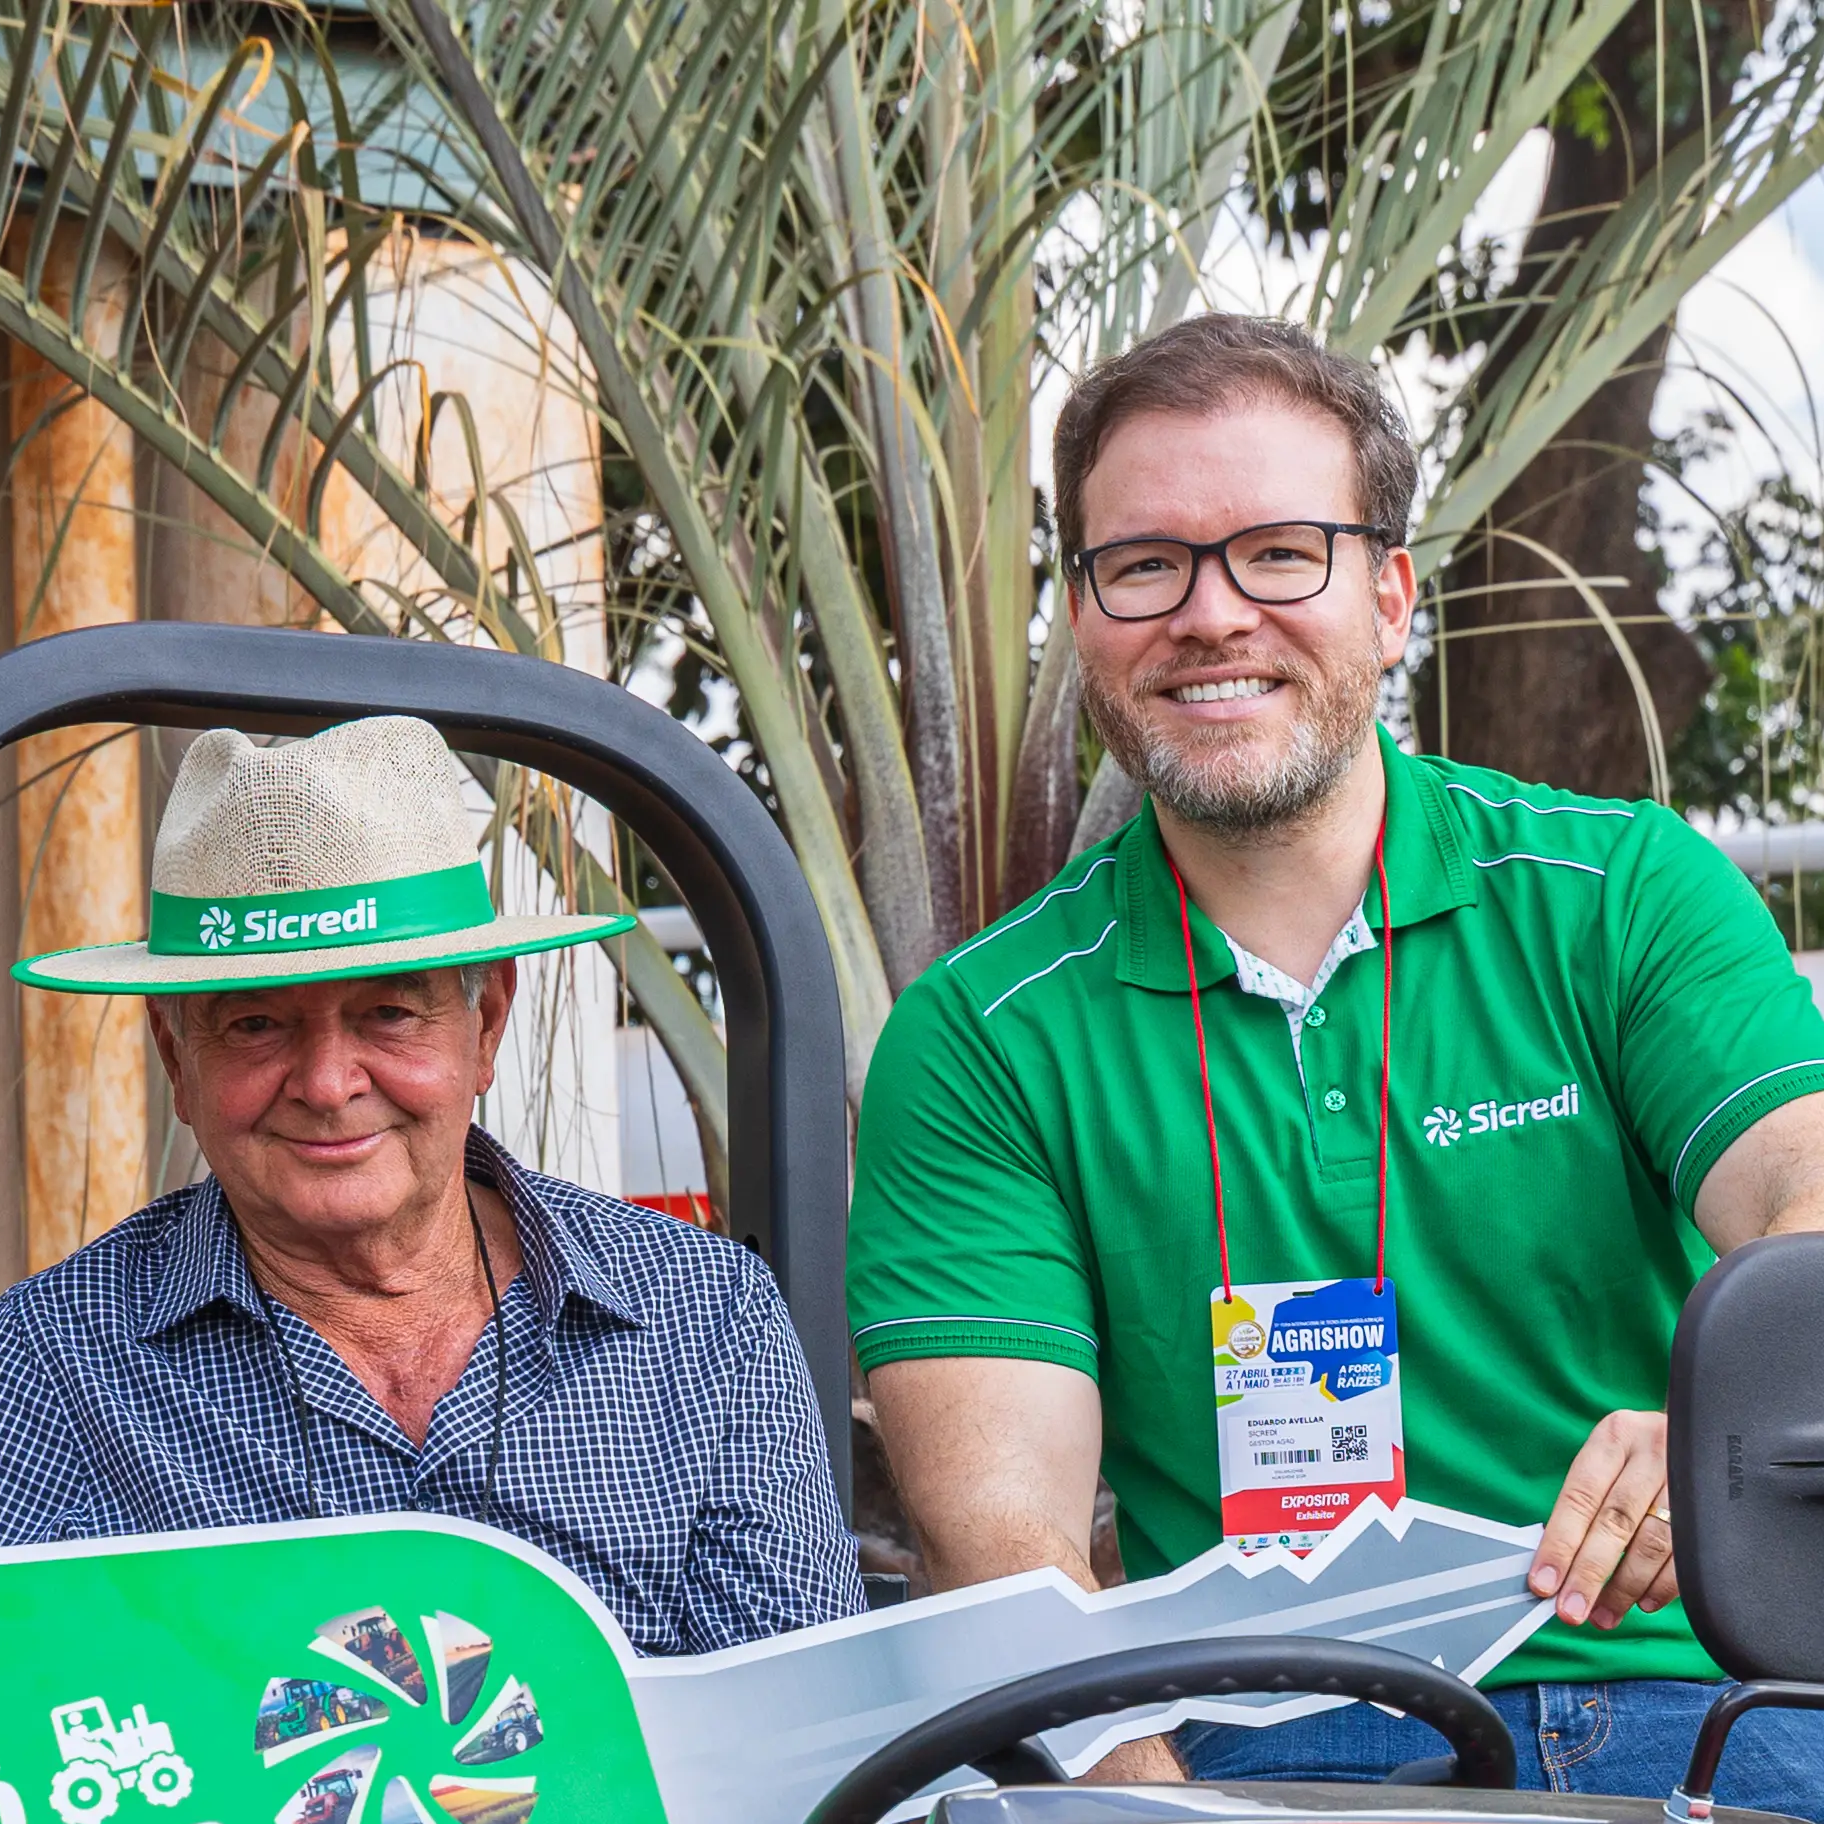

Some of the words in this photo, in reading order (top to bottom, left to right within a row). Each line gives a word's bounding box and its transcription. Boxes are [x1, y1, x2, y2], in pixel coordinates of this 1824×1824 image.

[242, 897, 377, 943] Sicredi
[1468, 1083, 1579, 1134] Sicredi
[1271, 1324, 1385, 1353] AGRISHOW
[1226, 1370, 1239, 1379] 27
[1241, 1369, 1269, 1379] ABRIL
[1226, 1381, 1233, 1390] A
[1244, 1379, 1270, 1389] MAIO
[1247, 1418, 1286, 1427] EDUARDO
[1289, 1416, 1325, 1425] AVELLAR
[1248, 1429, 1278, 1438] SICREDI
[1281, 1492, 1350, 1509] EXPOSITOR
[1296, 1511, 1336, 1521] Exhibitor
